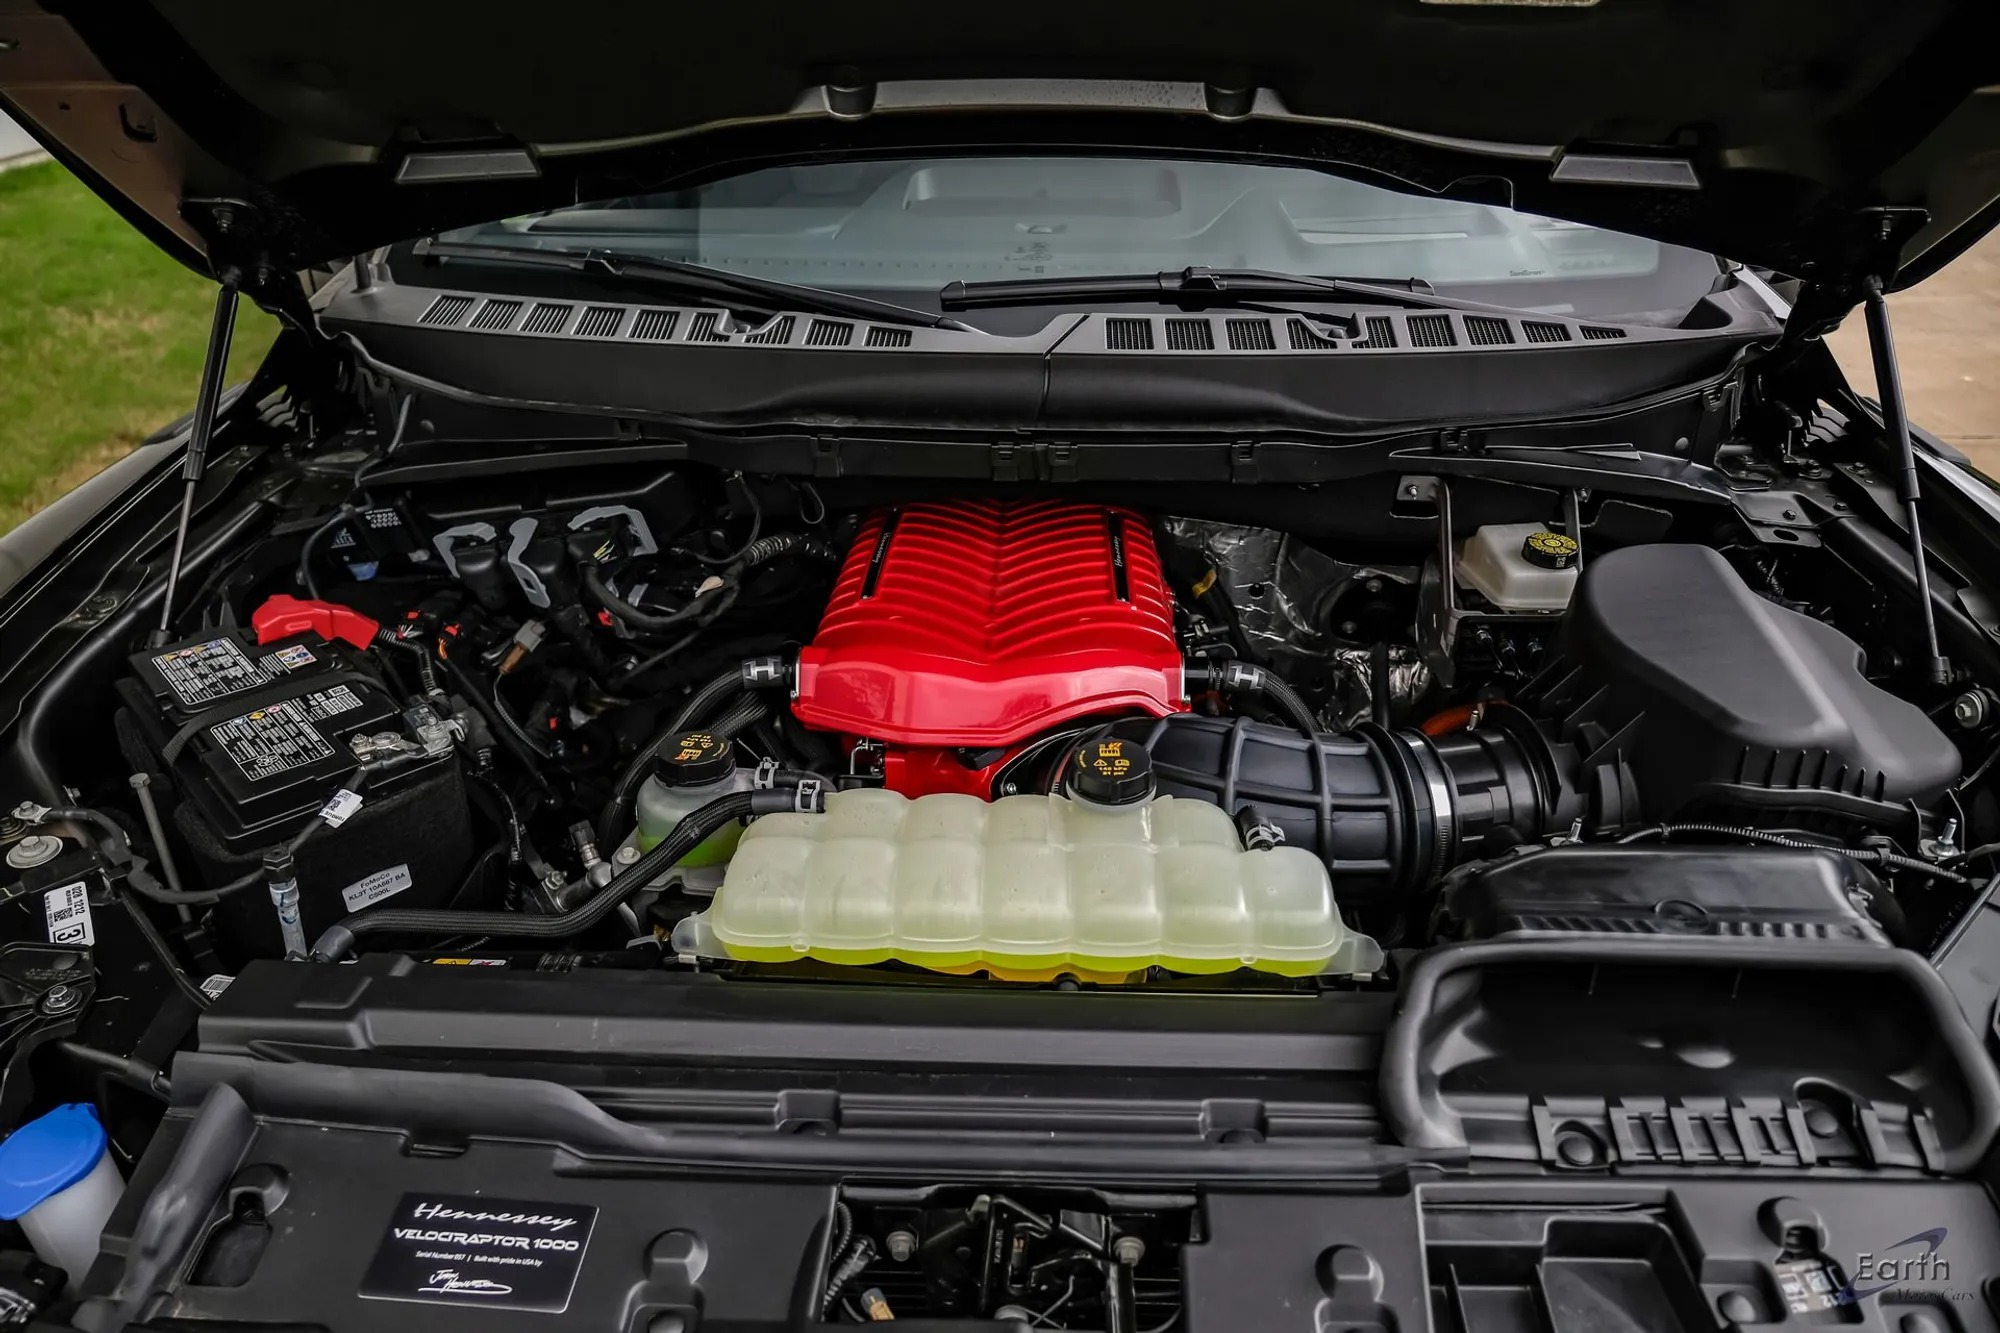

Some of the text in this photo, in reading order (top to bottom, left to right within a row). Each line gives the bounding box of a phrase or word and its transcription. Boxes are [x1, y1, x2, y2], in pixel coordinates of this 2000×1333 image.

[360, 872, 390, 888] FoMoCo
[74, 899, 86, 915] 1212
[414, 1202, 578, 1231] Hennessey
[393, 1228, 579, 1251] VELOCIRAPTOR 1000
[415, 1250, 434, 1258] Serial
[432, 1251, 454, 1260] Number
[474, 1254, 488, 1262] Built
[487, 1255, 500, 1263] with
[499, 1256, 516, 1265] pride
[522, 1258, 535, 1266] USA
[535, 1259, 543, 1268] by
